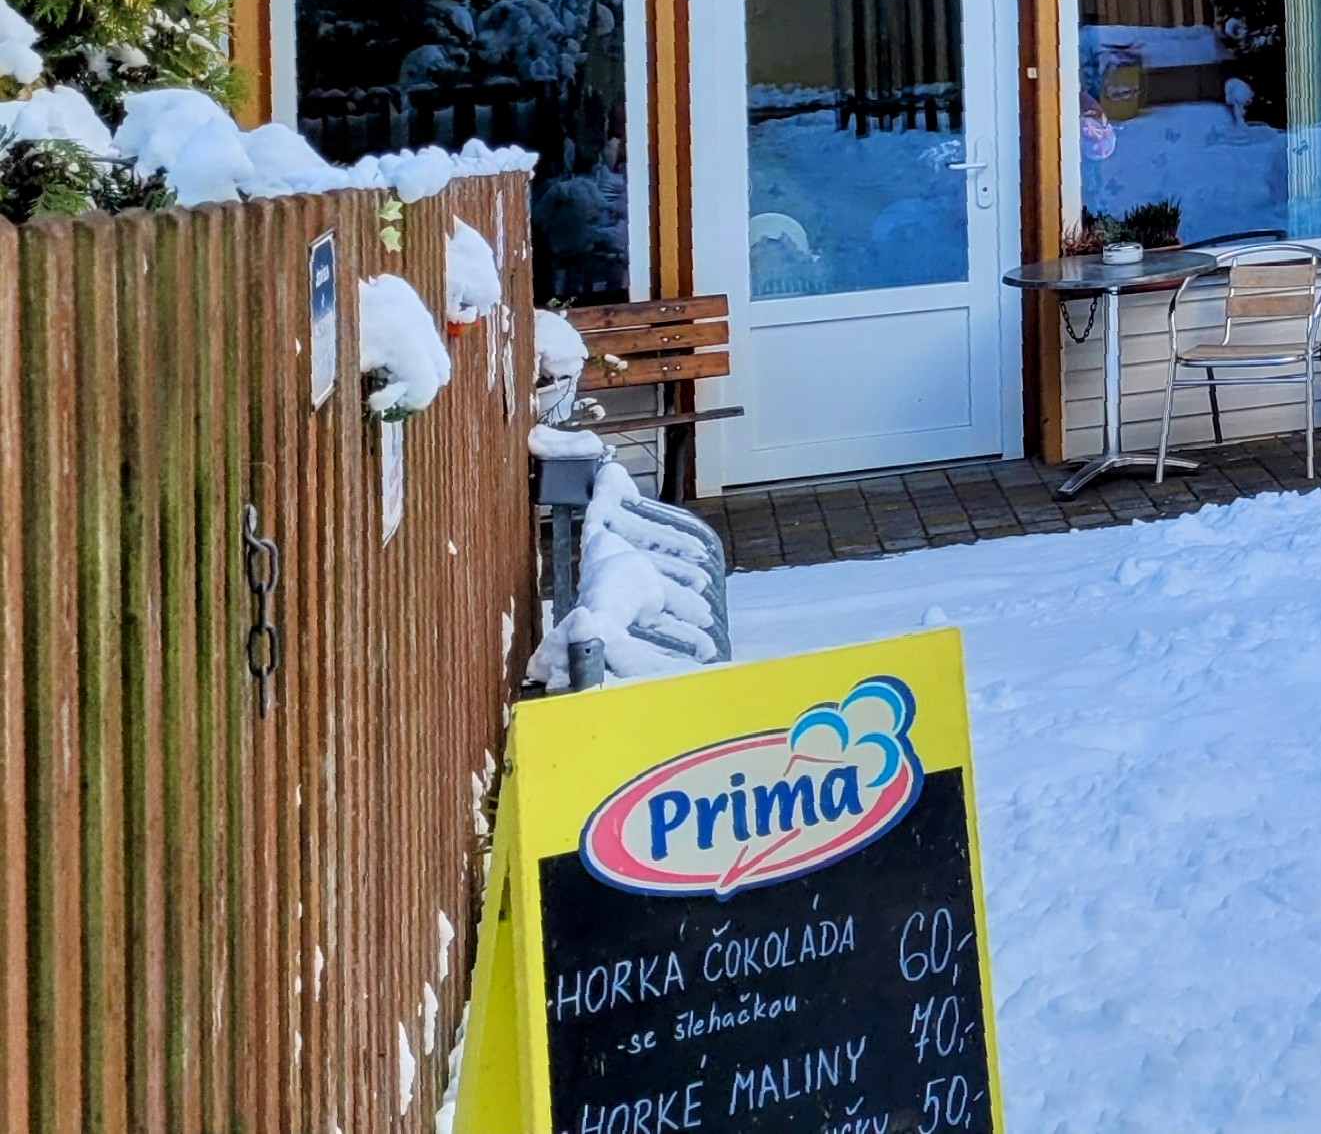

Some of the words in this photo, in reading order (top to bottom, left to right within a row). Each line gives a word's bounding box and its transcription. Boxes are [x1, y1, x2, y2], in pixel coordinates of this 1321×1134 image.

[647, 765, 864, 861] Prima
[702, 894, 856, 982] ČOKOLÁDA
[899, 907, 974, 987] 60,-
[673, 992, 797, 1041] šlehačkou
[581, 1054, 707, 1134] HORKÉ
[728, 1036, 867, 1115] MALINY
